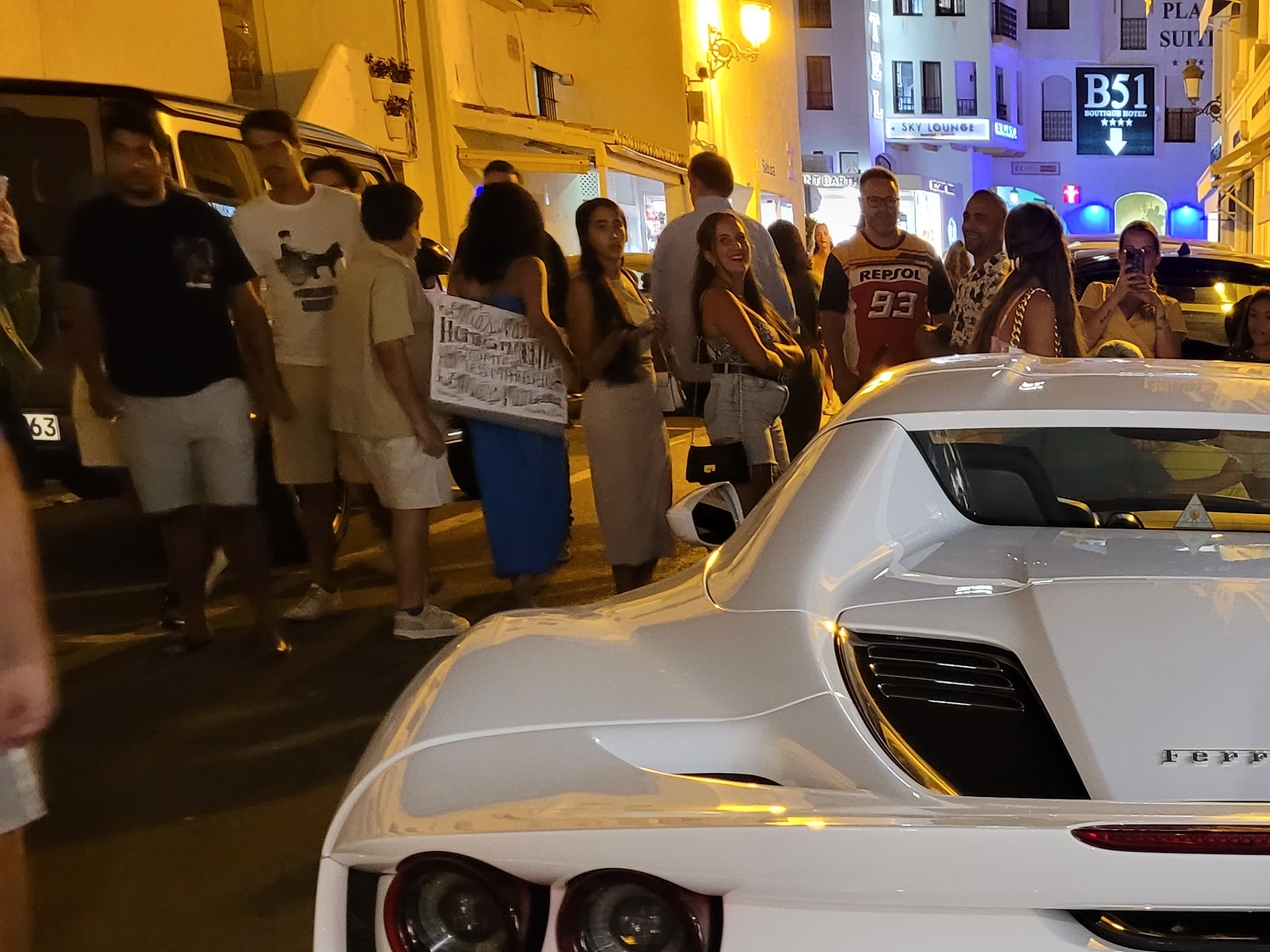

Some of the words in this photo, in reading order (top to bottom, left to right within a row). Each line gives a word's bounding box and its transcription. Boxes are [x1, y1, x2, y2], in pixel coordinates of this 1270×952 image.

[1163, 2, 1200, 19] PLA
[868, 0, 884, 119] TEL
[1084, 73, 1147, 109] B51
[901, 122, 922, 132] SKY
[927, 122, 974, 132] LOUNGE
[860, 268, 921, 281] REPSOL
[868, 290, 918, 319] 93
